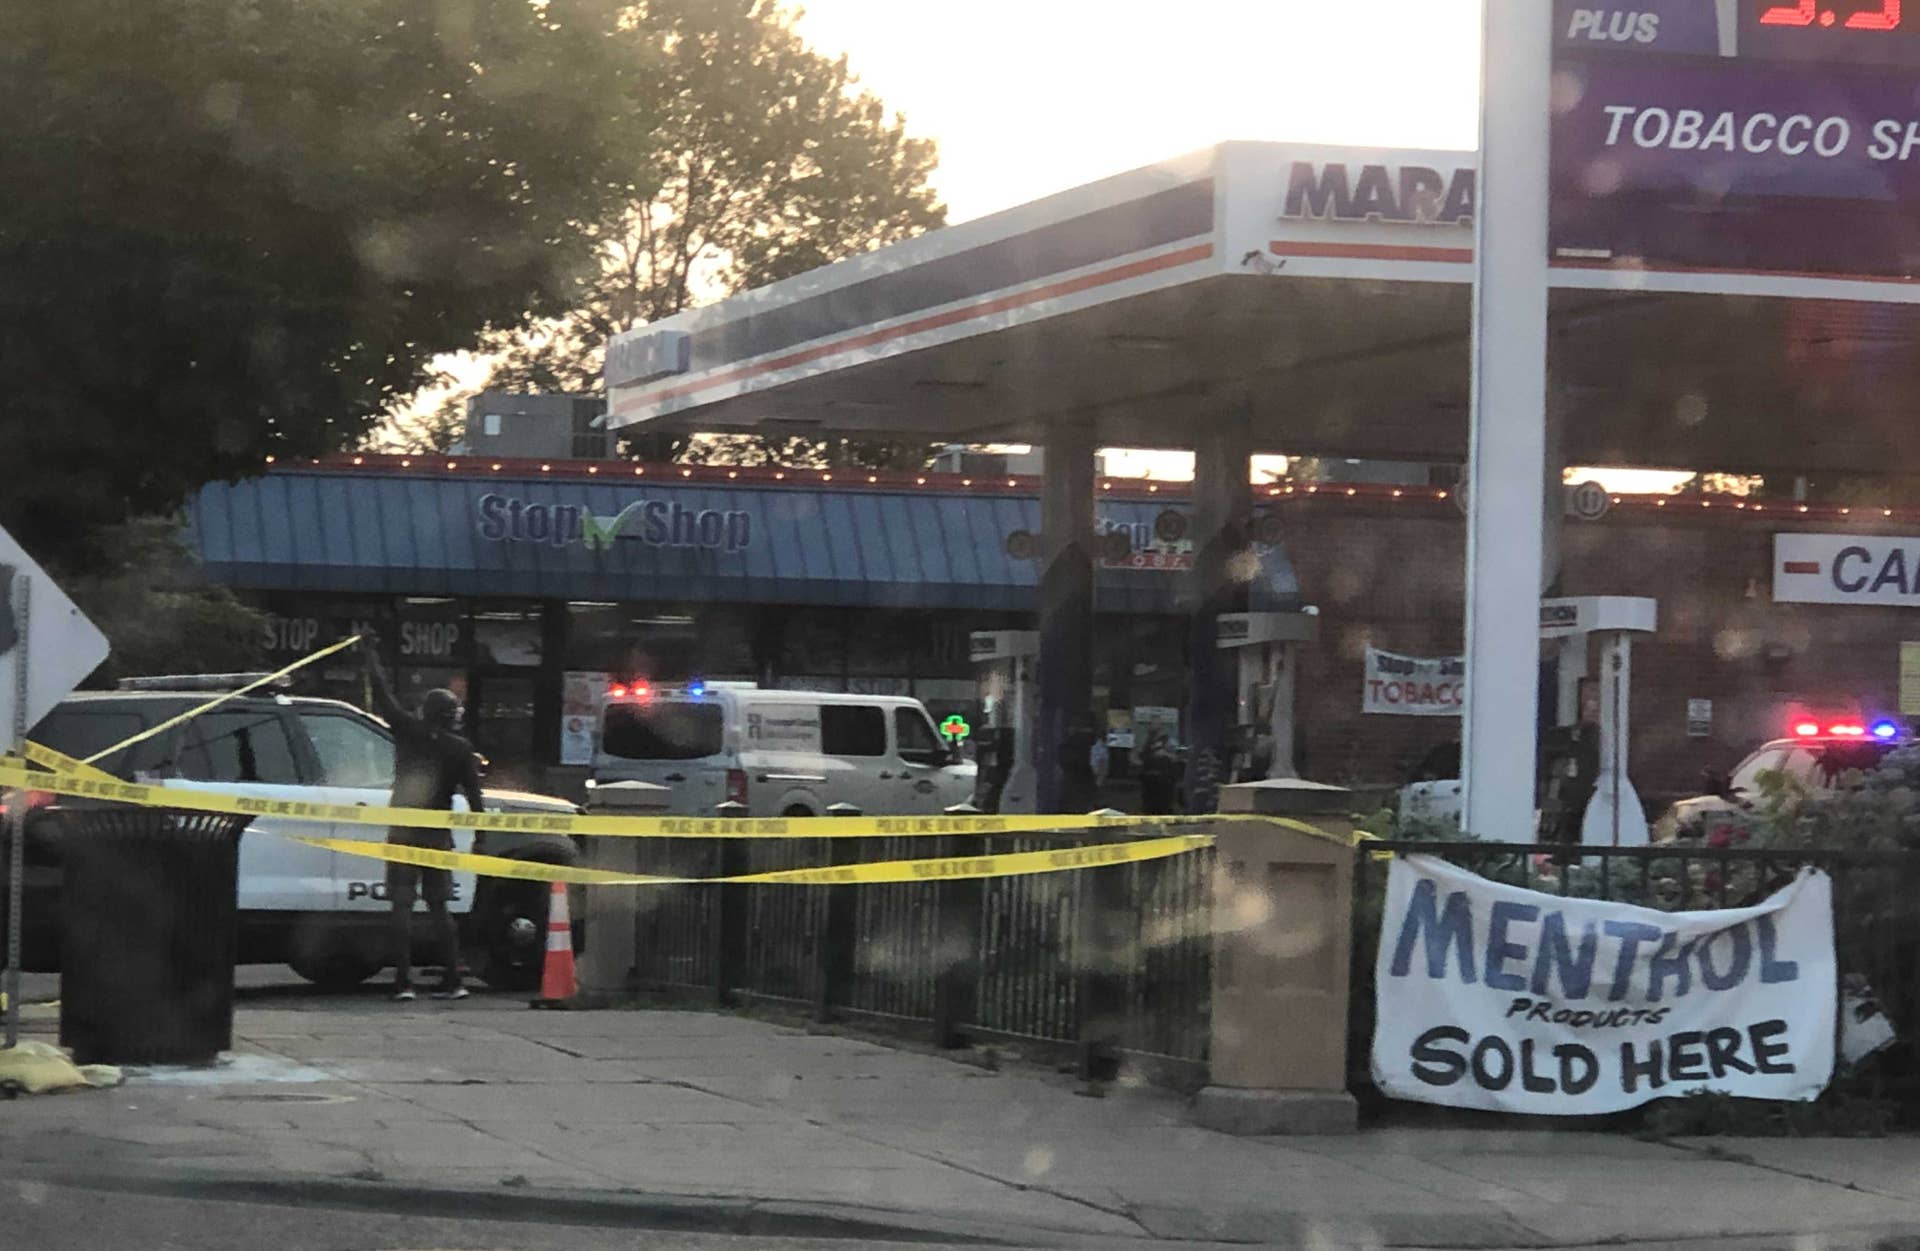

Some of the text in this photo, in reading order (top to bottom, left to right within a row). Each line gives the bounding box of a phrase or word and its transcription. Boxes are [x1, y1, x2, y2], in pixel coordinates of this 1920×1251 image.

[1568, 9, 1659, 43] PLUS
[1604, 105, 1849, 157] TOBACCO
[479, 493, 580, 547] Stop
[642, 499, 750, 552] Shop
[1832, 546, 1920, 594] CA
[400, 622, 459, 654] SHOP
[1389, 879, 1798, 1002] MENTHOL
[1506, 998, 1671, 1029] PRODUCTS
[1411, 1019, 1796, 1095] SOLD HERE
